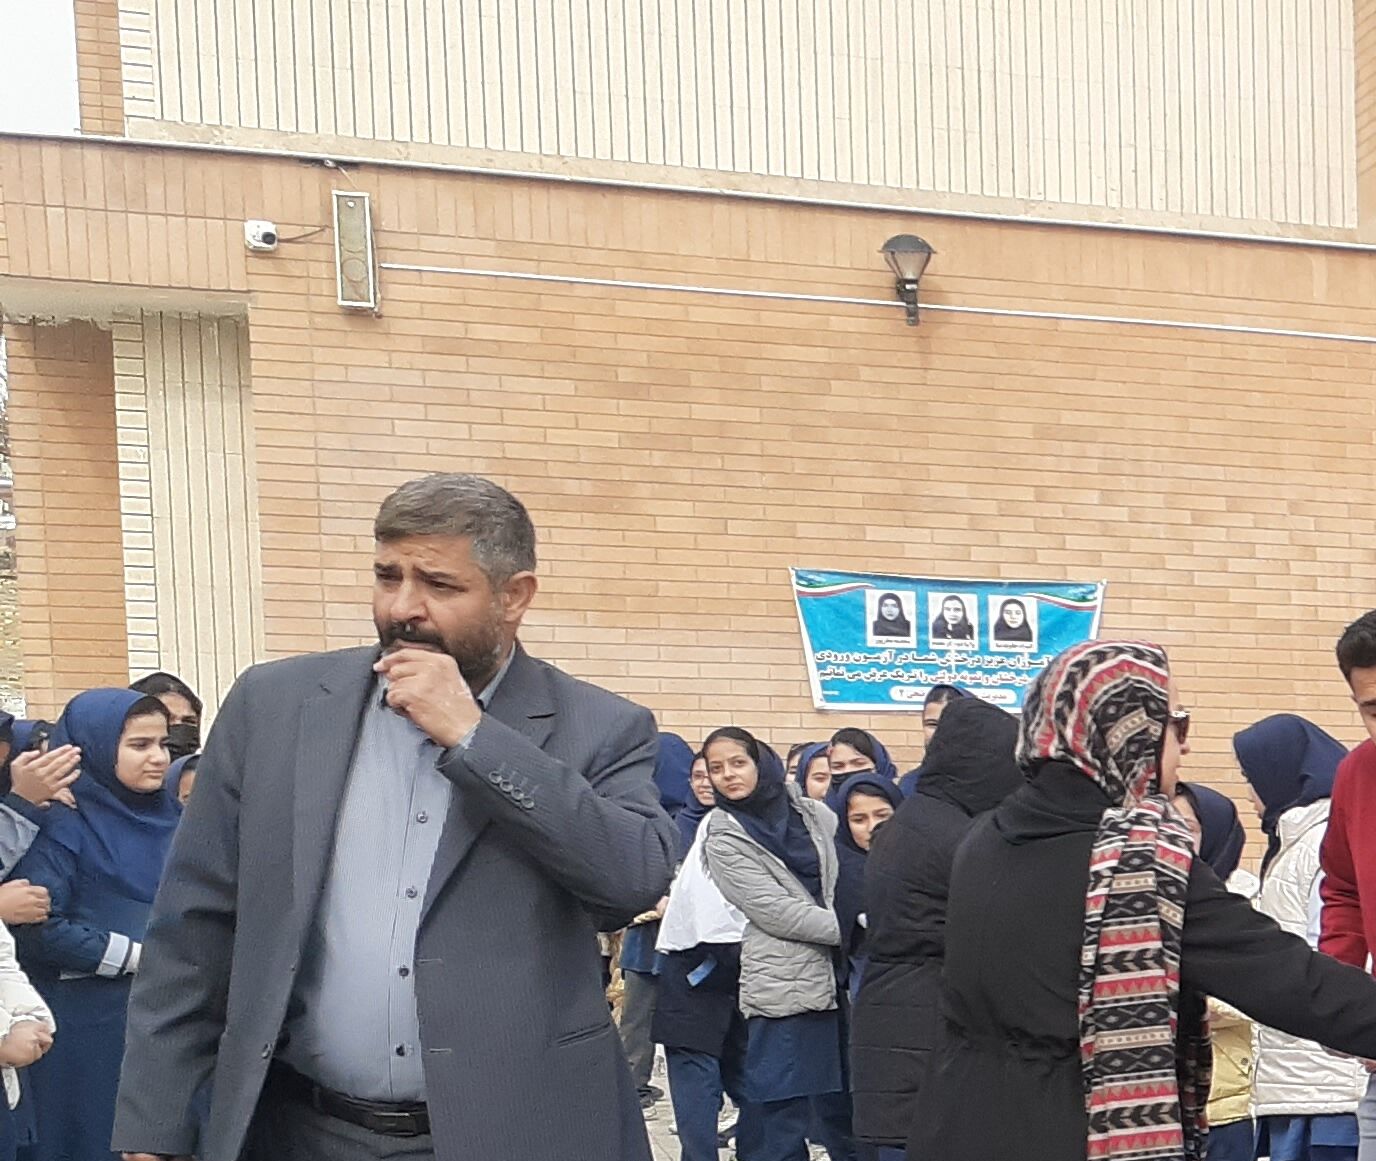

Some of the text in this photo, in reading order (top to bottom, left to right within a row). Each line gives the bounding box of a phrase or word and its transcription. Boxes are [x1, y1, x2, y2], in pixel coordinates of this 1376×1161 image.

[815, 651, 850, 662] ورودی
[853, 650, 894, 664] آزمون
[898, 654, 909, 664] در
